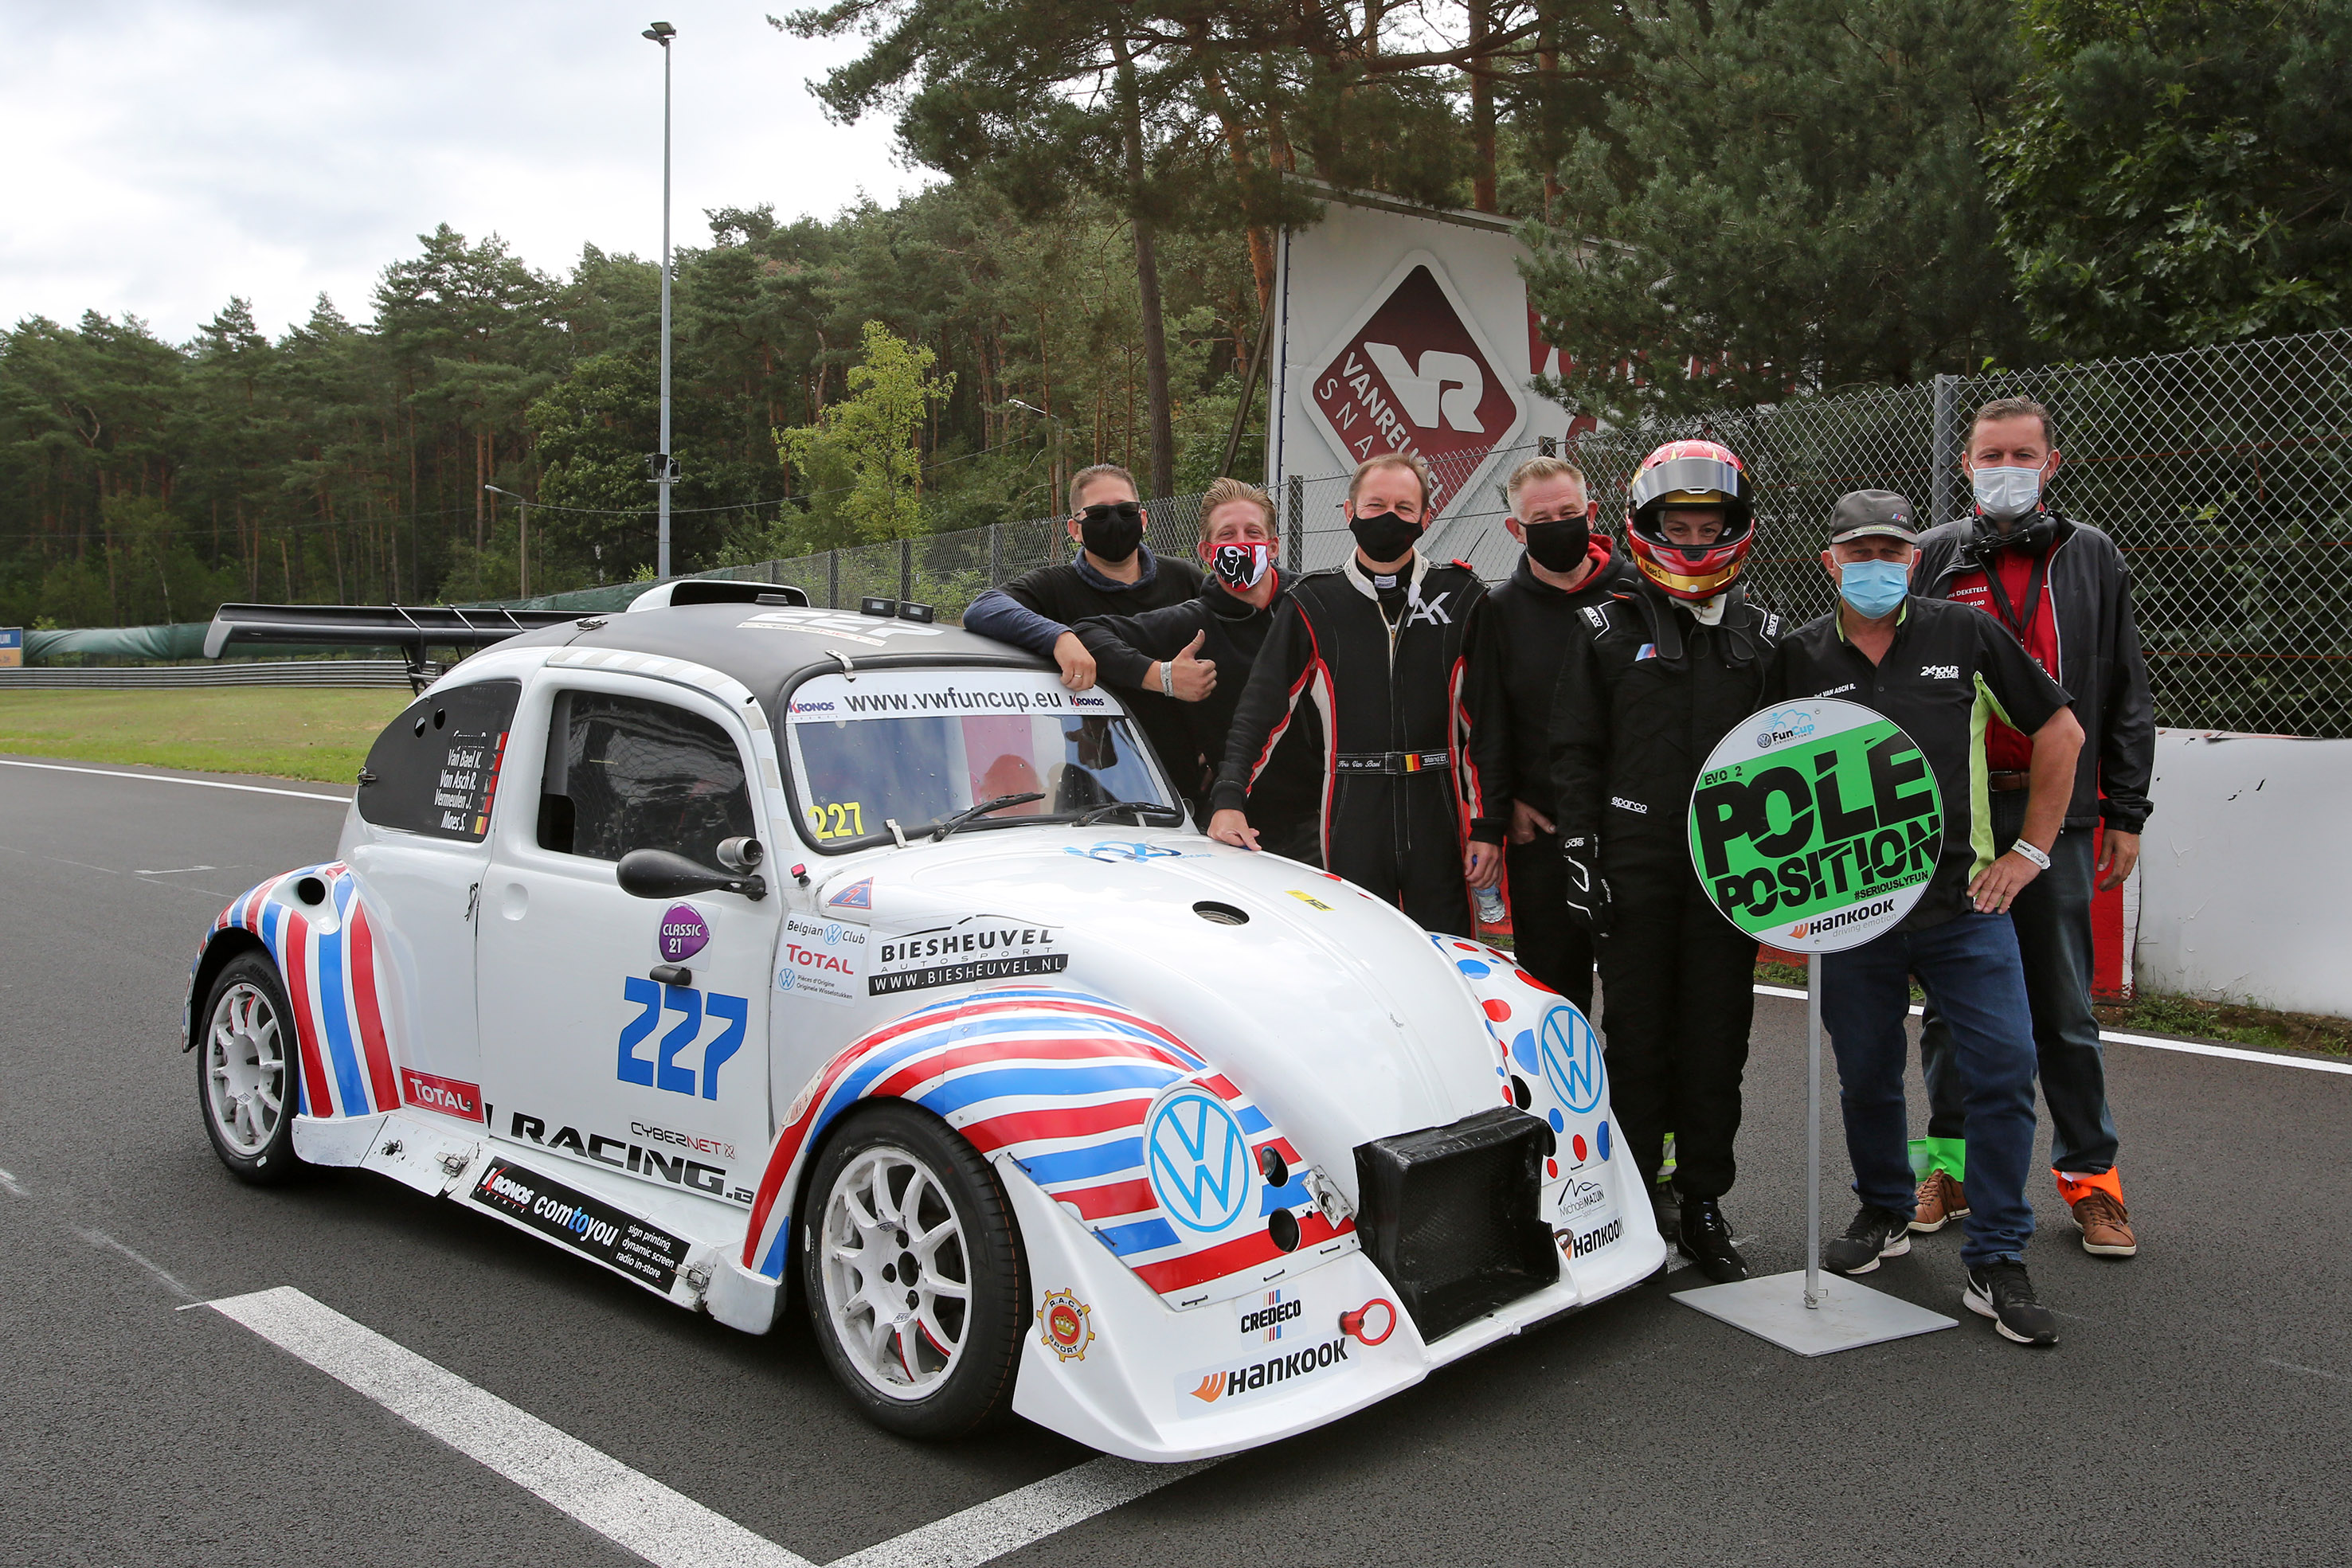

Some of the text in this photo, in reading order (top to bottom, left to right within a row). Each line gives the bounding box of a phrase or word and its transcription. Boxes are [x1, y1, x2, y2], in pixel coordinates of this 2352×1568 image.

[1956, 586, 1988, 596] DEKETELE
[843, 687, 1063, 713] www.vwfuncup.eu
[1069, 692, 1105, 707] KRONOS
[1822, 688, 1833, 698] VAN
[1833, 685, 1849, 694] ASCH
[1771, 723, 1815, 742] FunCup
[447, 749, 460, 766] Van
[460, 749, 475, 768] Bael
[440, 769, 453, 788] Van
[452, 770, 470, 790] Asch
[1704, 765, 1743, 785] EVO 2
[434, 788, 466, 809] Vermeulen
[1611, 796, 1648, 814] sparco
[1693, 730, 1935, 879] POLE
[440, 811, 460, 831] Maes
[808, 802, 866, 840] 227
[1714, 814, 1942, 921] POSITION
[1854, 870, 1928, 900] #SERIOUSLYFUN
[663, 923, 702, 936] CLASSIC
[787, 920, 824, 936] Belgian
[842, 930, 866, 944] Club
[1833, 913, 1896, 937] driving emotion
[668, 937, 682, 953] 21
[881, 929, 1054, 963] BIESHEUVEL
[786, 943, 855, 976] TOTAL
[875, 957, 1063, 991] WWW.BIESHEUVEL.NL
[617, 976, 749, 1101] 227
[409, 1077, 473, 1112] TOTAL
[631, 1121, 722, 1155] CYBERNET
[481, 1167, 535, 1206] KRONOS
[534, 1195, 619, 1247] comtoyou
[628, 1224, 671, 1252] sign printing
[616, 1252, 661, 1279] radio in-store
[622, 1238, 675, 1269] dynamic screen
[1240, 1299, 1302, 1334] CREDECO
[1048, 1334, 1078, 1354] SPORT
